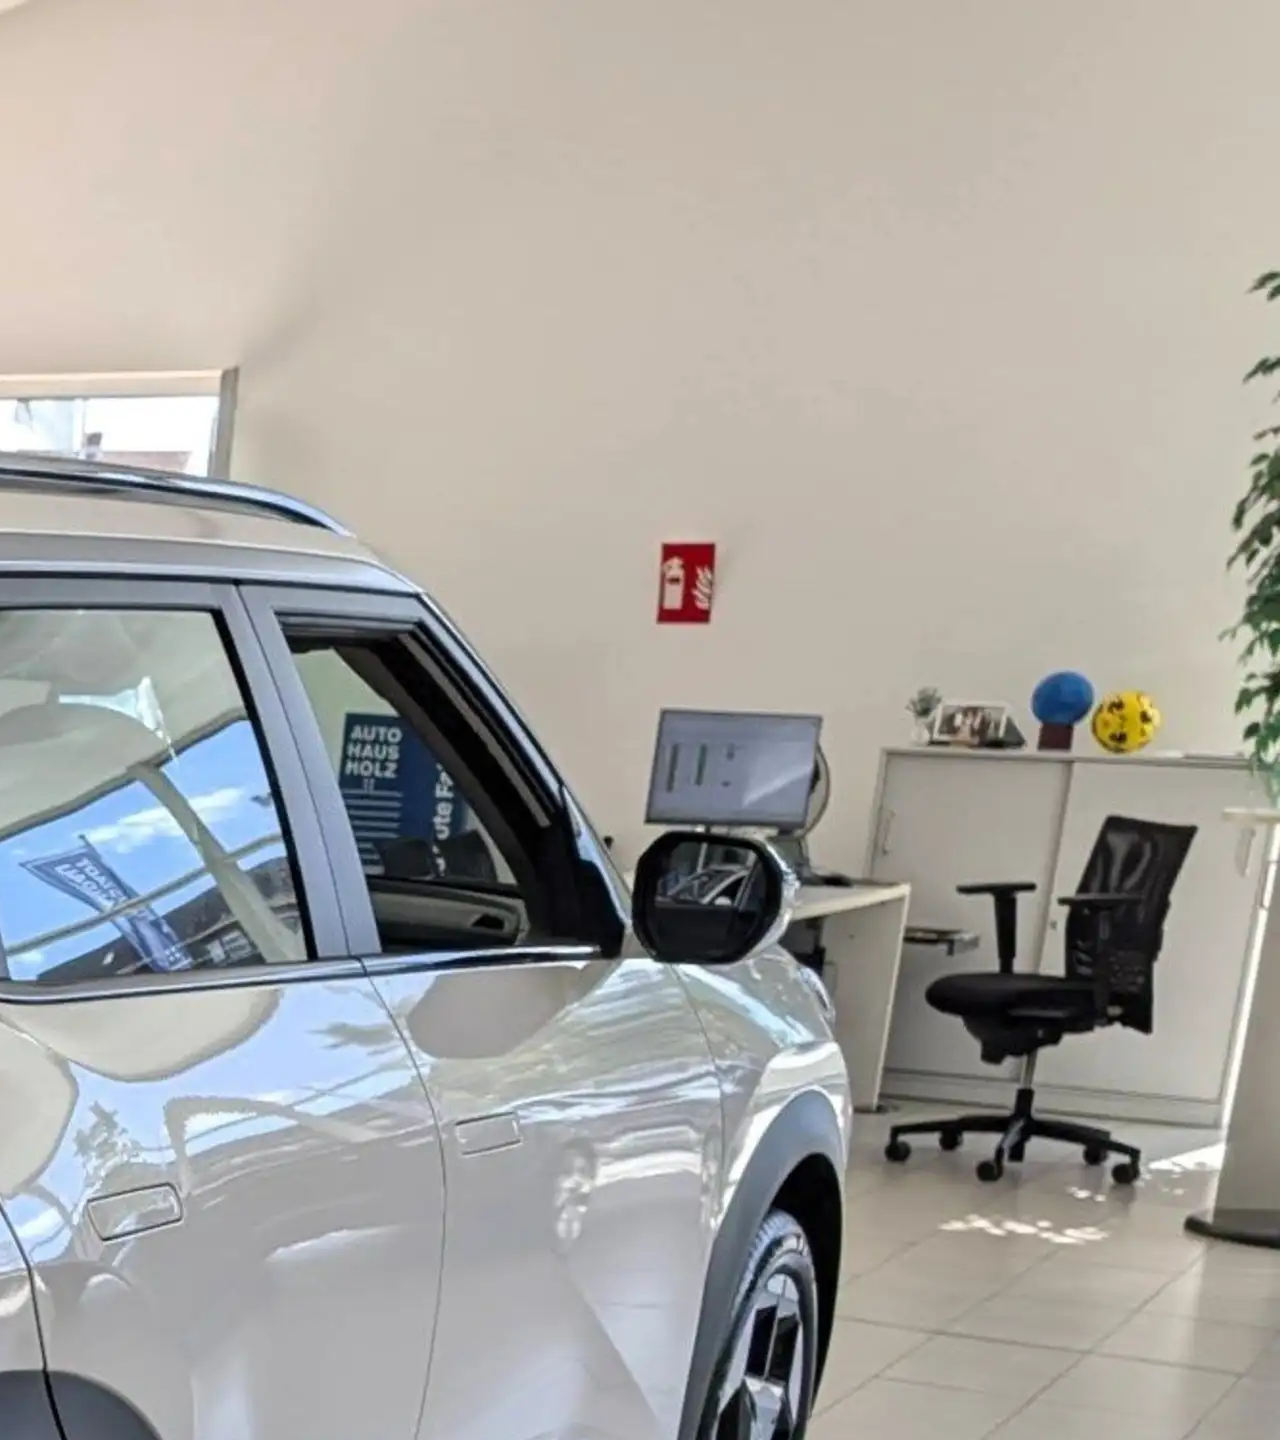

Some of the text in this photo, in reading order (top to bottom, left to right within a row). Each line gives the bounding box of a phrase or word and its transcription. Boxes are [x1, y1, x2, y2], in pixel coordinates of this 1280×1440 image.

[350, 724, 403, 743] AUTO
[346, 741, 400, 760] HAUS
[344, 759, 398, 779] HOLZ
